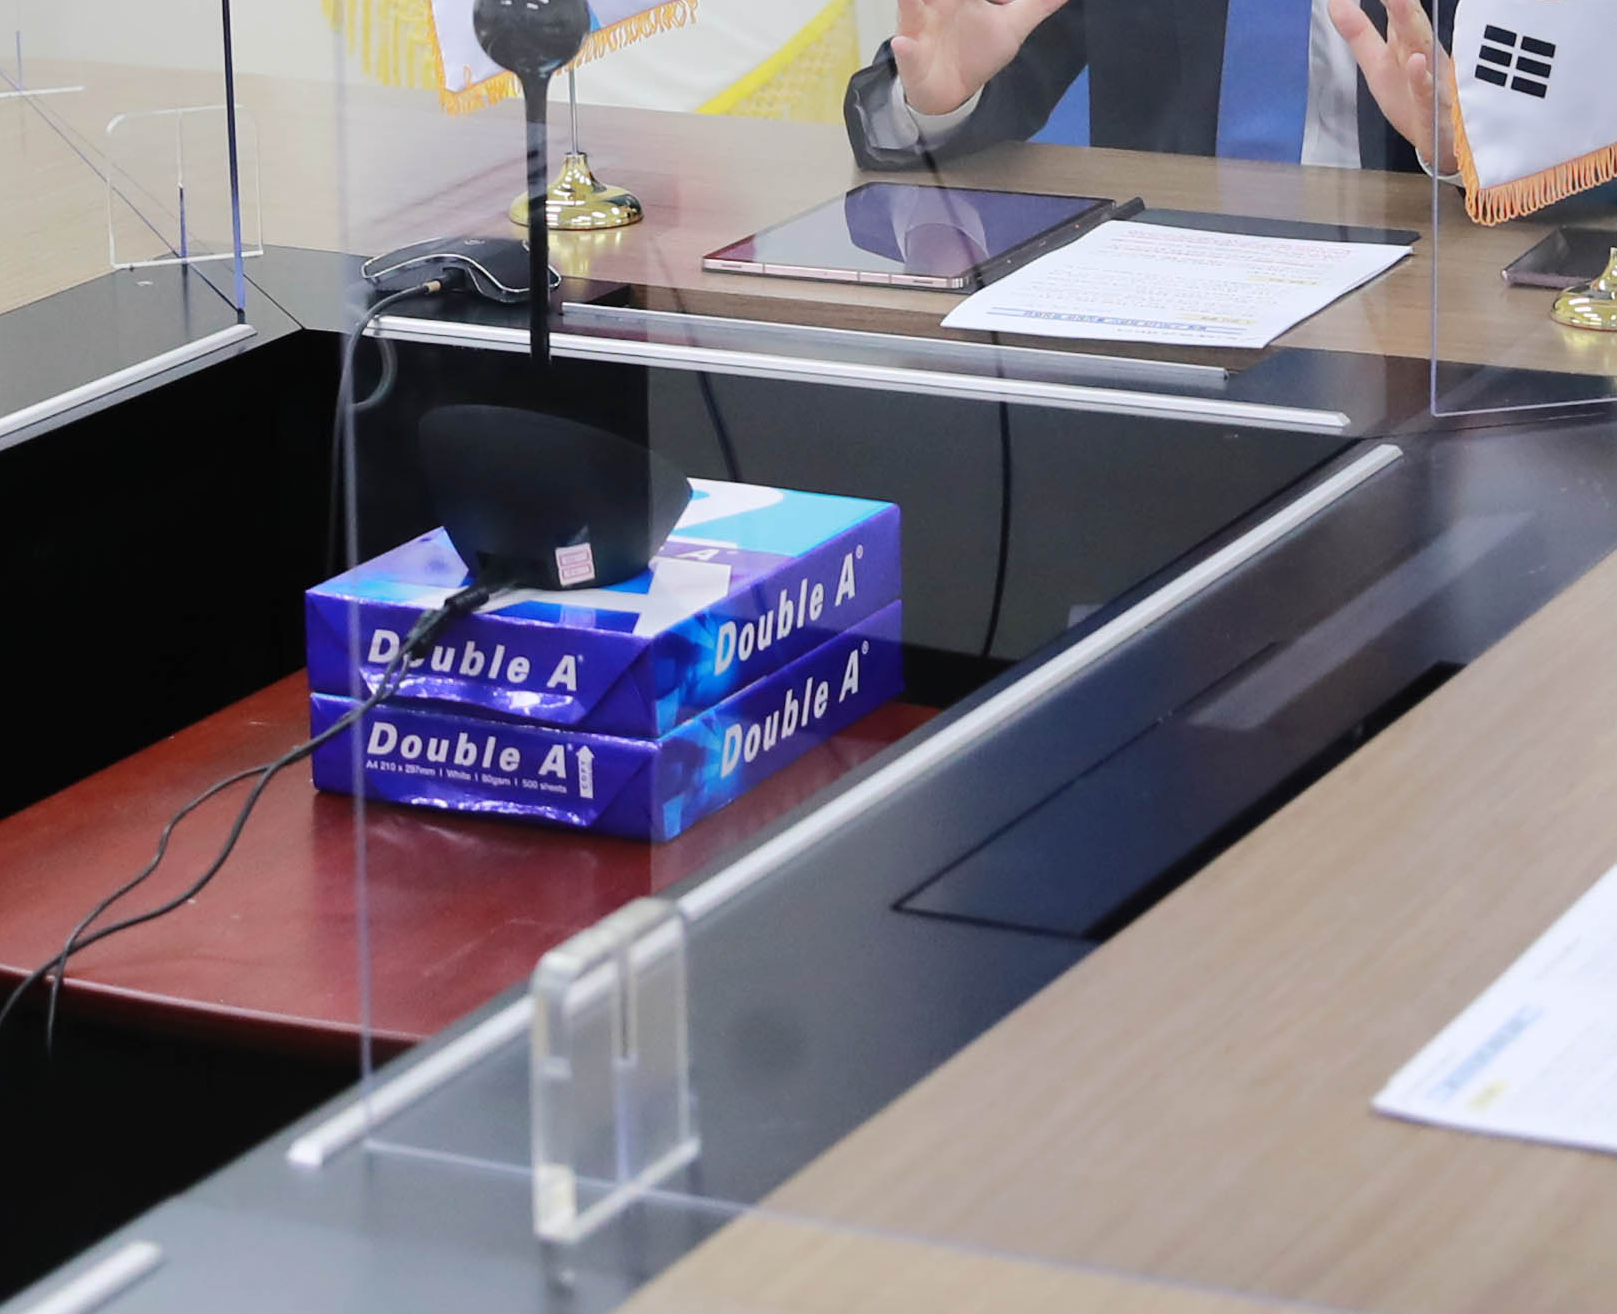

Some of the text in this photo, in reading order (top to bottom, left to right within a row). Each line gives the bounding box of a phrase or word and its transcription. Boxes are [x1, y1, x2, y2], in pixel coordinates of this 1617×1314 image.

[714, 578, 824, 677] Double
[367, 720, 521, 772] Double
[720, 677, 829, 779] Double
